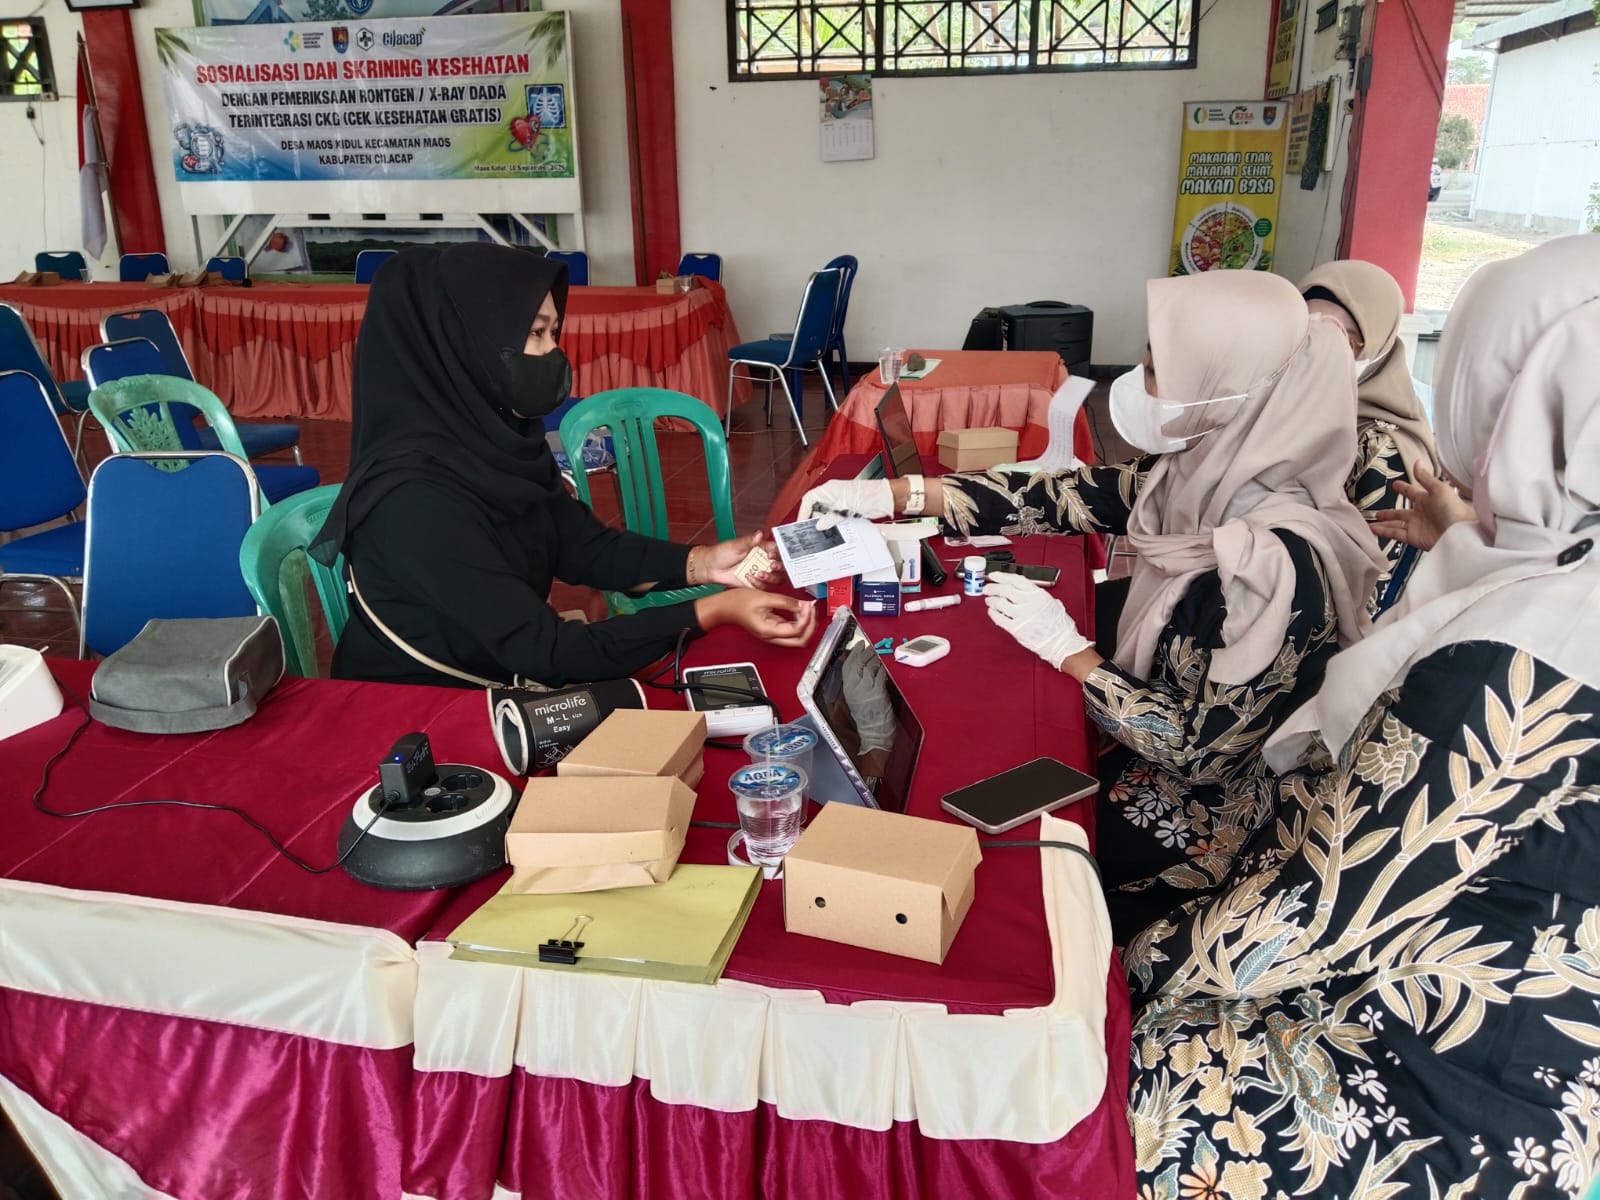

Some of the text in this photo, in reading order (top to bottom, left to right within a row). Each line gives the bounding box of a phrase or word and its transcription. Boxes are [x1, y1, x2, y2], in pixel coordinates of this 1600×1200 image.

[196, 54, 530, 84] SOSIALISASI DAN SKRINING KESEHATAN
[222, 92, 268, 107] DENGAN
[271, 89, 356, 106] PEMERIKSAAN
[359, 87, 414, 104] RONTGEN
[429, 86, 465, 101] X-RAY
[469, 84, 507, 100] DADA
[229, 107, 502, 128] TERINTEGRASI CKG (CEK KESEHATAN GRATIS)
[281, 137, 451, 150] DESA MAOS KIDUL KECAMATAN MAOS
[319, 153, 414, 165] KABUPATEN CILACAP
[1190, 152, 1272, 165] MAKANAN ENAK
[1186, 165, 1274, 177] MAKANAN SEHAT
[1181, 178, 1275, 195] MAKAN B2SA
[534, 695, 587, 717] microlife
[553, 724, 571, 733] Easy
[744, 768, 782, 782] AQUA
